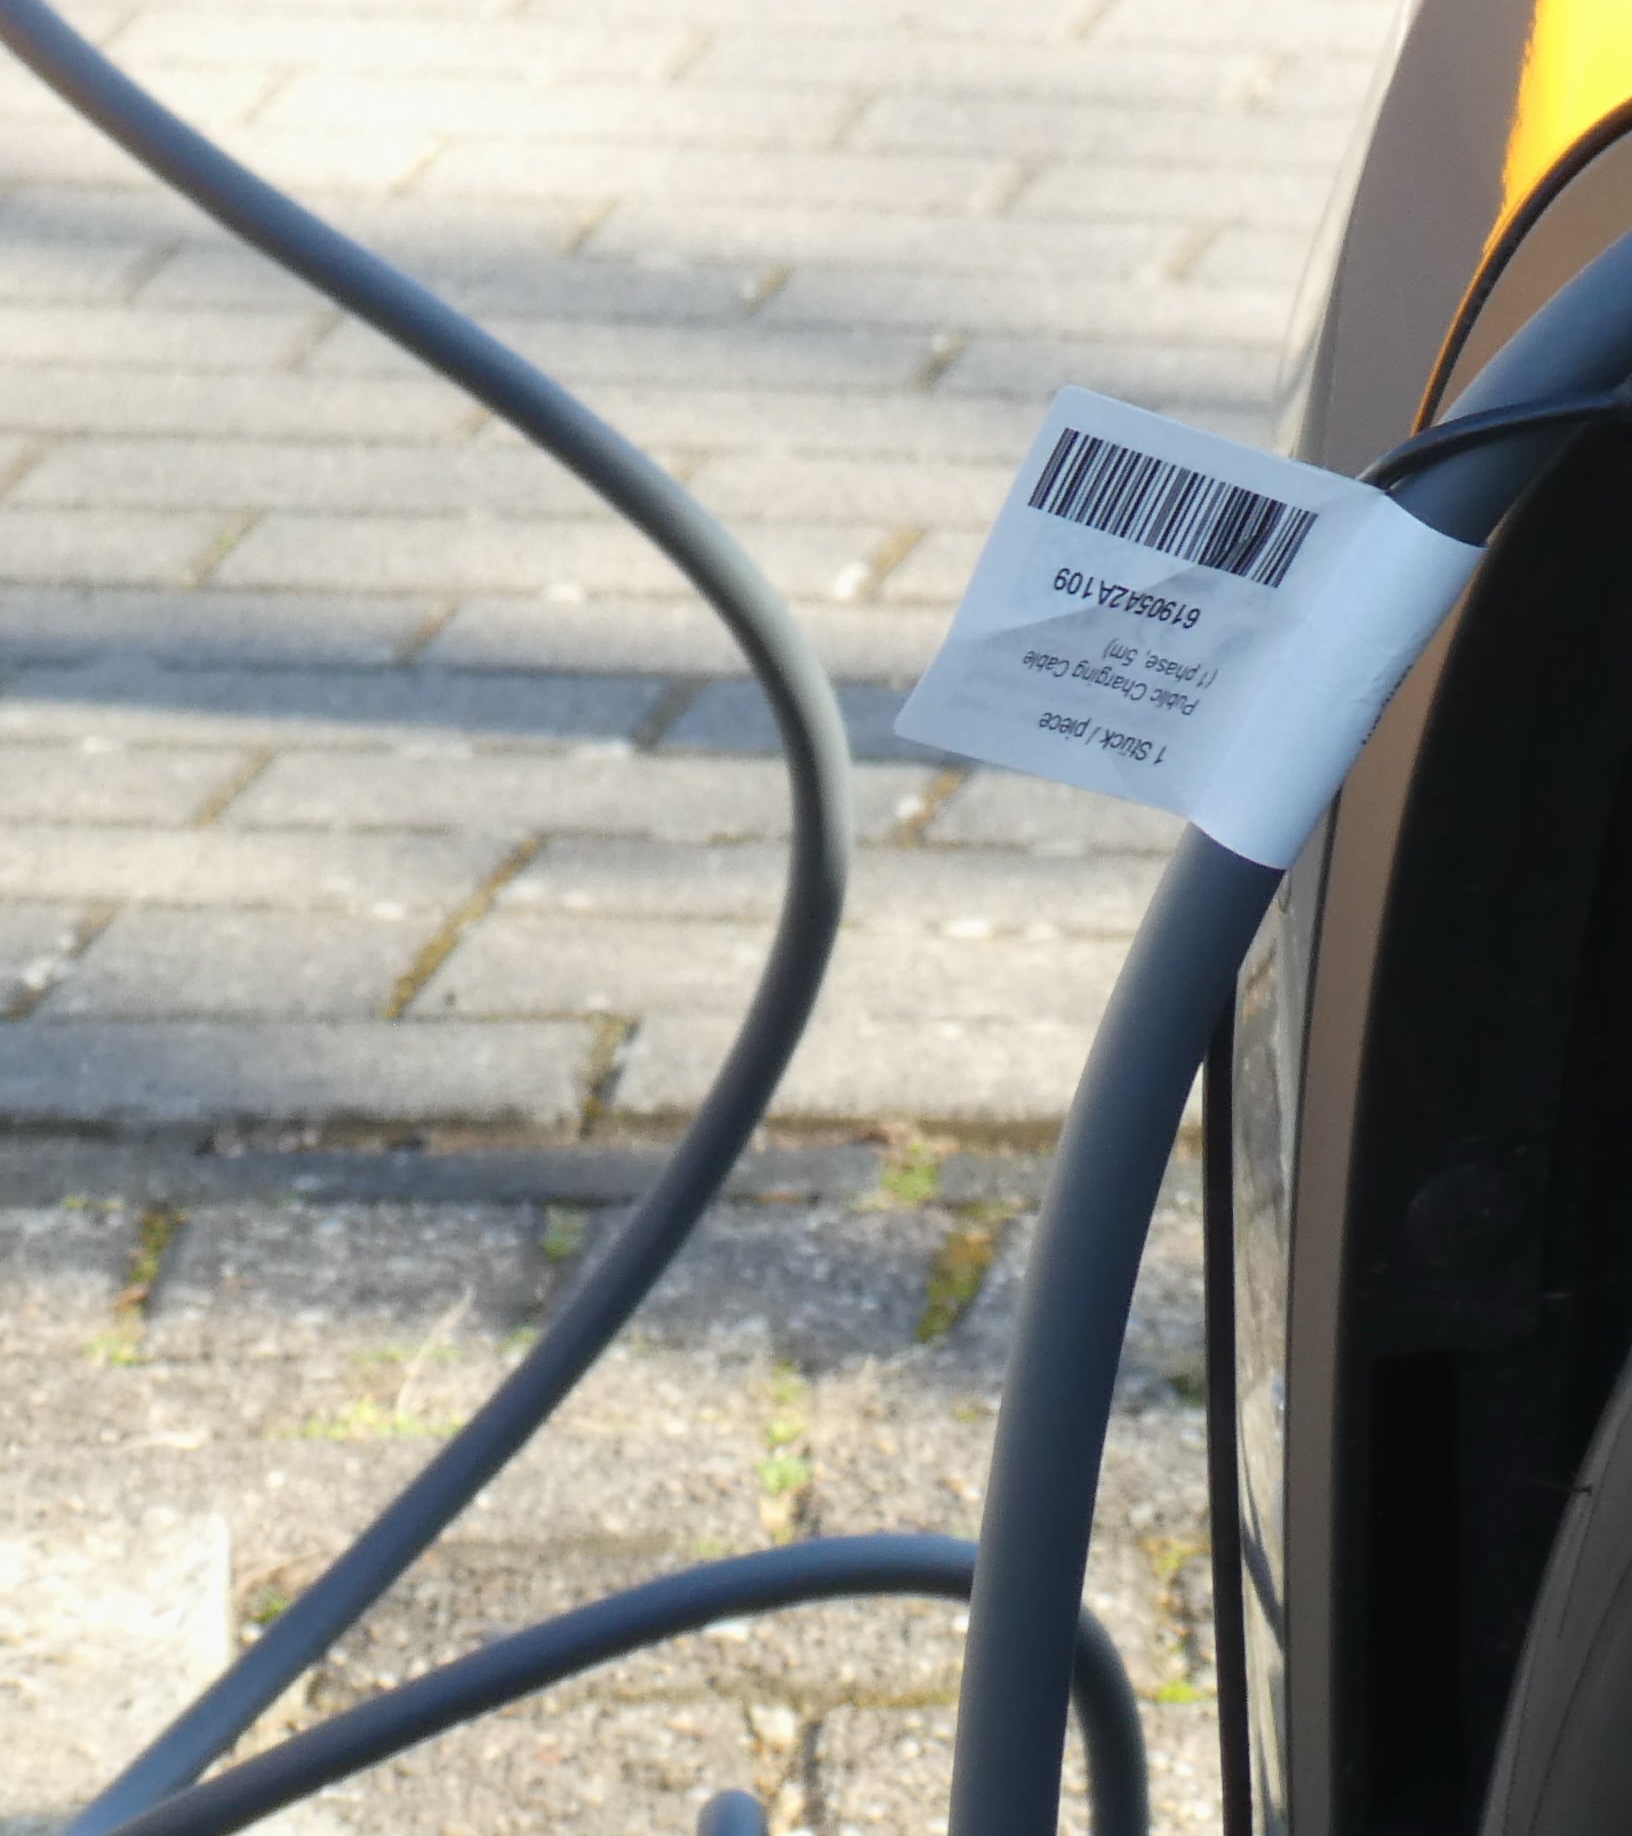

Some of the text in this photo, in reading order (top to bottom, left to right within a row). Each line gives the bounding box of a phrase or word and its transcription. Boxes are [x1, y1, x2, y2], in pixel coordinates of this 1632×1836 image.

[1103, 639, 1218, 688] (1 phase, 5m)
[1023, 651, 1200, 716] Public Charging Cable
[1038, 712, 1090, 741] piece
[1100, 729, 1153, 762] Stück
[1154, 746, 1167, 766] 1
